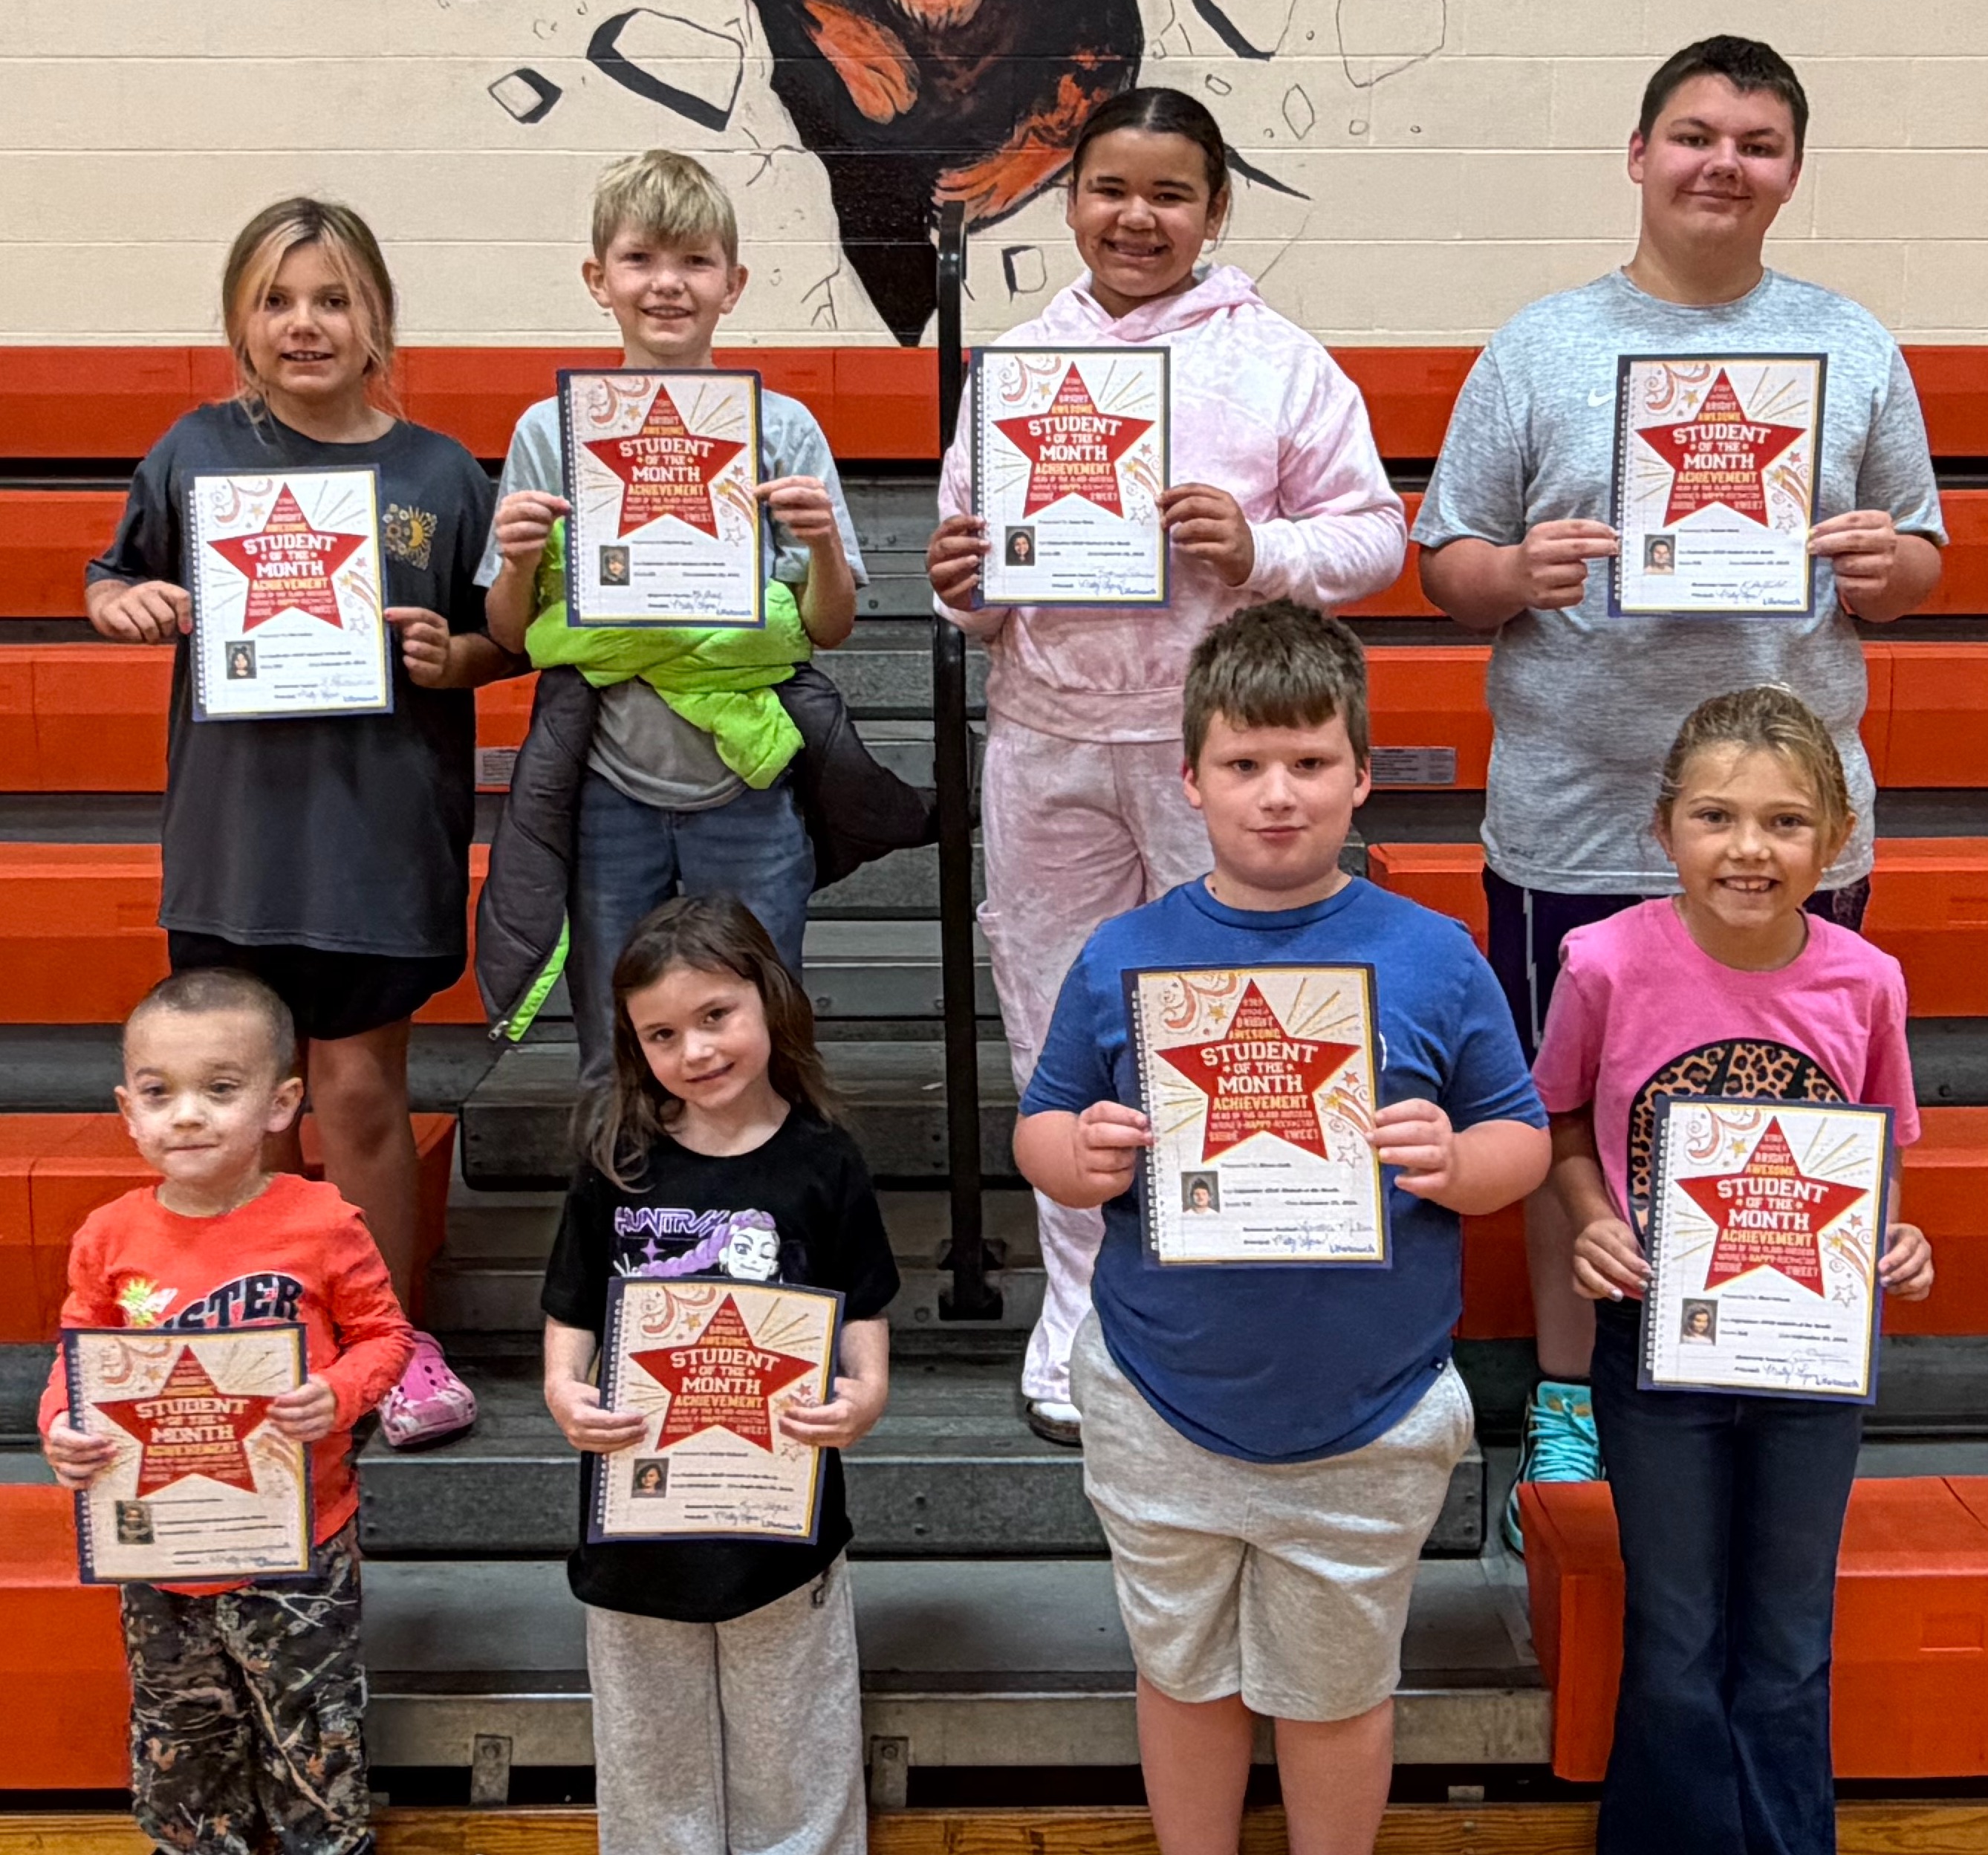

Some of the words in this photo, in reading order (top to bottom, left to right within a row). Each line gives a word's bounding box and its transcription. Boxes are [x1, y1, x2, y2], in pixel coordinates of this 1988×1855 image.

[1028, 415, 1123, 436] STUDENT
[1672, 423, 1771, 444] STUDENT
[620, 438, 715, 458] STUDENT
[1039, 444, 1108, 461] MONTH
[1683, 453, 1755, 470] MONTH
[631, 466, 701, 482] MONTH
[242, 533, 337, 555] STUDENT
[256, 560, 325, 578] MONTH
[1201, 1042, 1318, 1066] STUDENT
[1232, 1063, 1252, 1074] OF
[1256, 1062, 1284, 1073] THE
[1217, 1075, 1303, 1094] MONTH
[1212, 1095, 1308, 1111] ACHIEVEMENT
[1716, 1177, 1829, 1203] STUDENT
[1746, 1197, 1762, 1208] OF
[1767, 1197, 1794, 1209] THE
[1728, 1209, 1810, 1230] MONTH
[1721, 1228, 1813, 1247] ACHIEVEMENT
[162, 1273, 302, 1328] STER
[670, 1348, 780, 1371] STUDENT
[699, 1365, 716, 1376] OF
[719, 1365, 745, 1377] THE
[681, 1377, 761, 1394] MONTH
[135, 1398, 250, 1419] STUDENT
